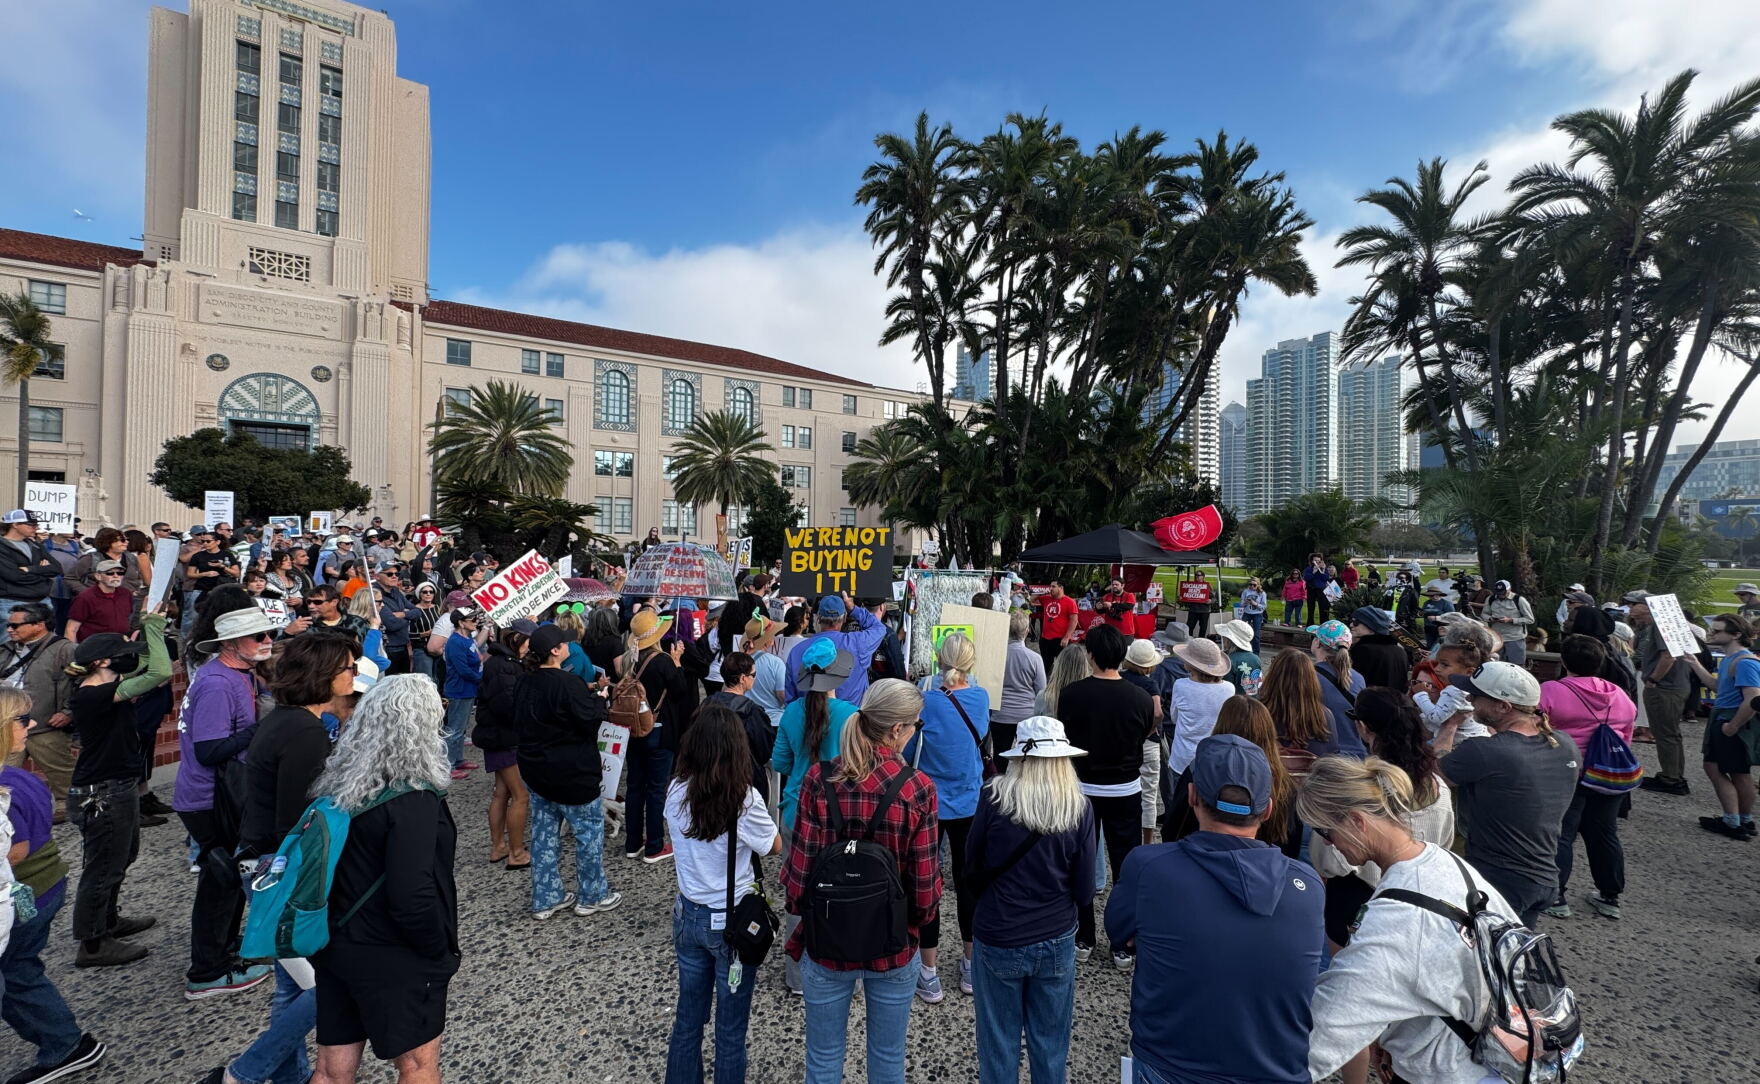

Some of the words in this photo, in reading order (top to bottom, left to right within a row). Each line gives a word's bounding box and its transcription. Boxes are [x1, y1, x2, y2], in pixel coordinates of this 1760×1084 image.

[204, 298, 289, 315] ADMINISTRATION
[294, 311, 338, 323] BUILDING
[28, 489, 68, 504] DUMP
[35, 511, 72, 525] RUMP!
[784, 527, 842, 548] WE'RE
[844, 527, 890, 546] NOT
[669, 557, 704, 567] PEOPLE
[791, 548, 873, 572] BUYING
[474, 582, 509, 612] NO
[503, 551, 550, 591] KINGS
[664, 569, 705, 578] DESERVE
[528, 596, 542, 610] BE
[541, 582, 561, 602] NICE
[659, 583, 706, 596] RESPECT
[491, 592, 527, 620] COMPETENT
